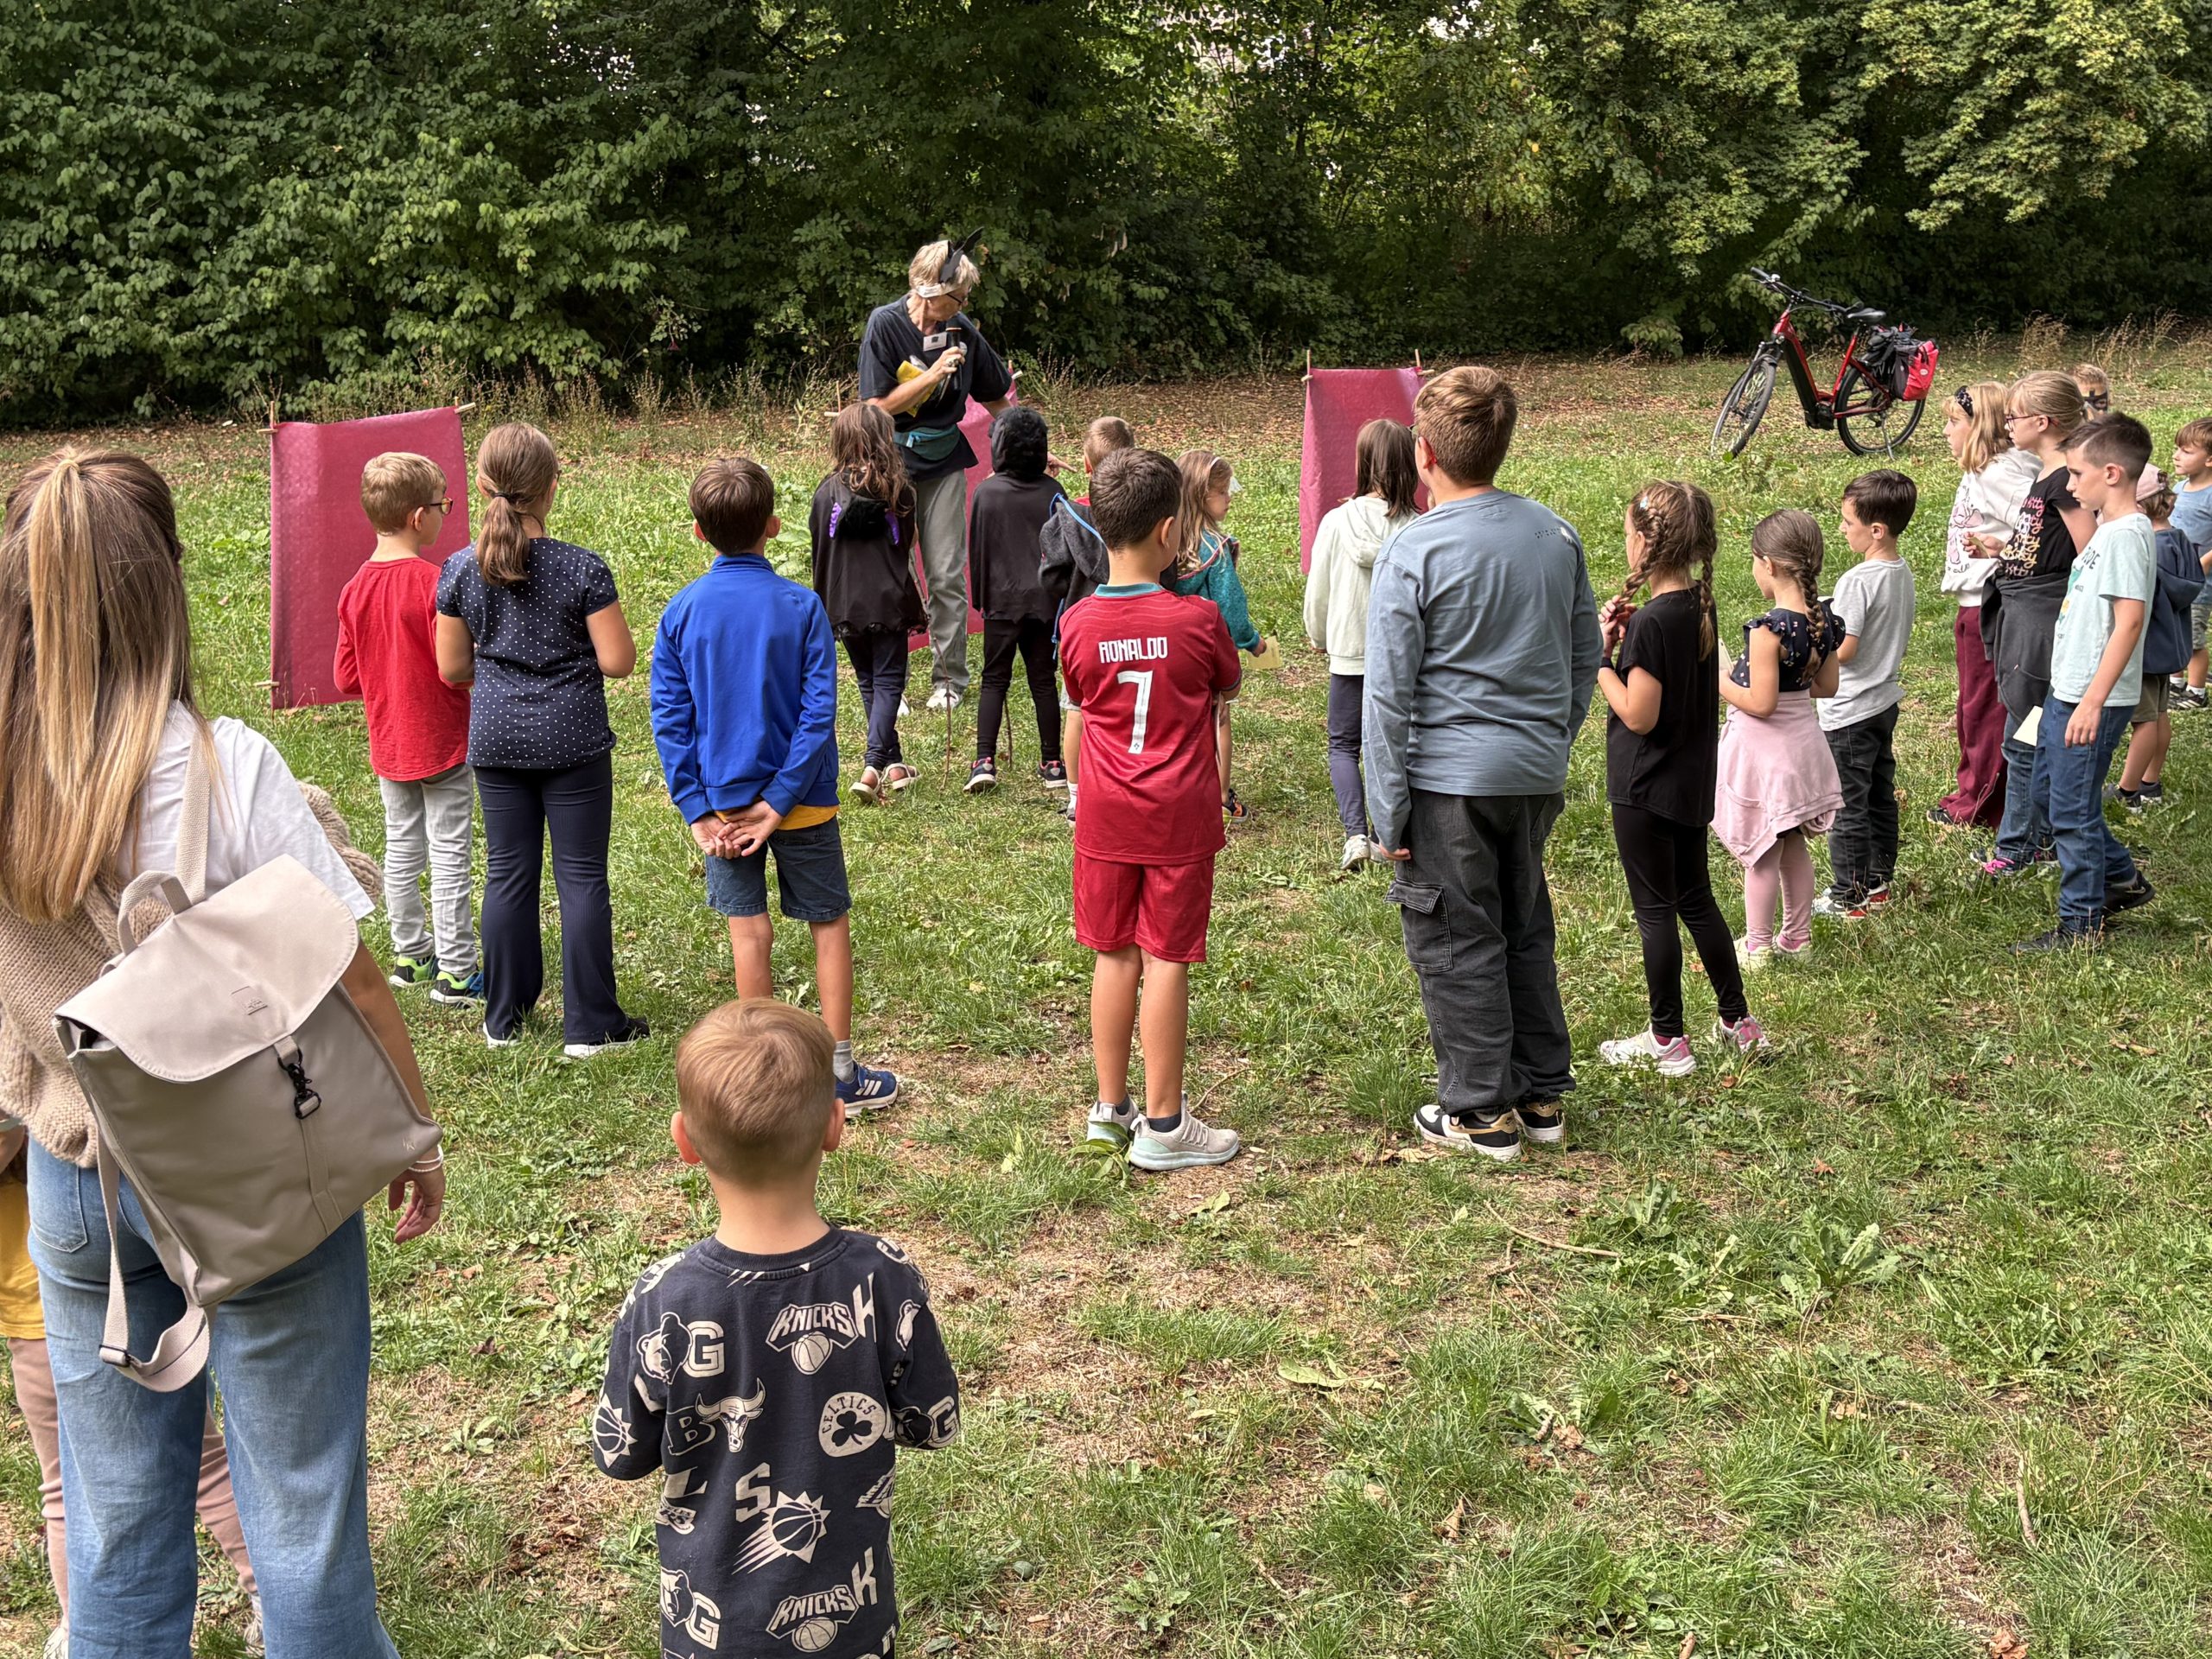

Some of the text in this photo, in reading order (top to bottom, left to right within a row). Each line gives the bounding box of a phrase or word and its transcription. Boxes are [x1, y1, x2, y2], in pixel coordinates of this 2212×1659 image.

[1098, 637, 1168, 664] RONALDO
[1117, 670, 1154, 754] 7
[683, 1321, 725, 1377] G
[769, 1304, 856, 1342] KNICKS
[665, 1405, 716, 1456] B
[822, 1395, 877, 1434] CELTICS
[926, 1395, 960, 1448] G
[736, 1462, 771, 1522] S
[851, 1546, 878, 1605] K
[685, 1592, 721, 1649] G
[770, 1586, 856, 1631] KNICKS
